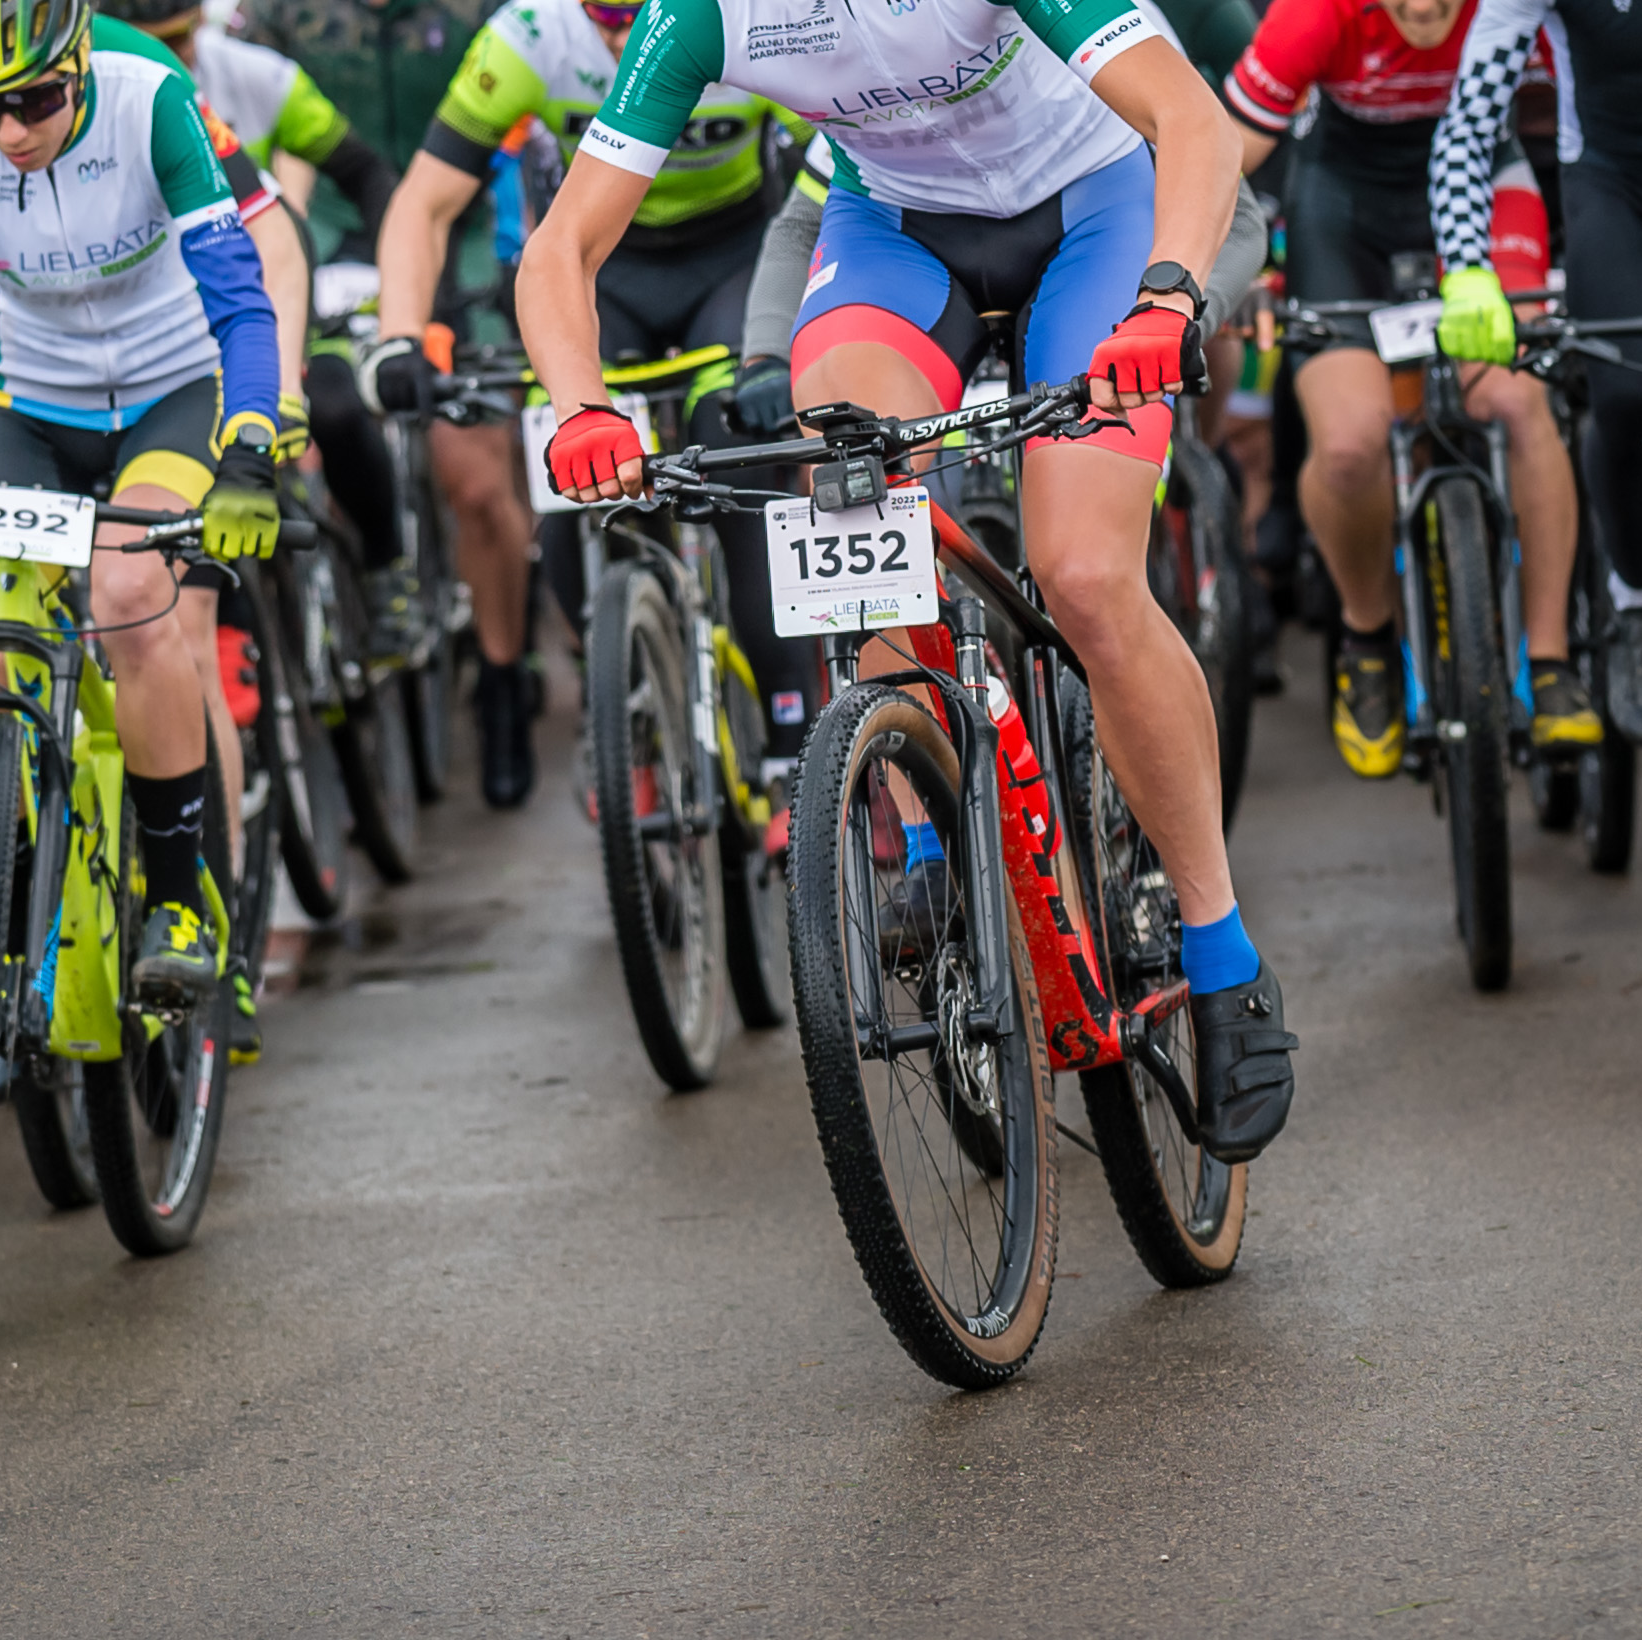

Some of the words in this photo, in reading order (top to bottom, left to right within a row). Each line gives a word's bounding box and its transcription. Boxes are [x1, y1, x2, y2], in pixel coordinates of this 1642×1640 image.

[1095, 17, 1143, 48] VELO.LV
[748, 37, 784, 52] KALNU
[749, 46, 808, 62] MARATONS
[812, 42, 836, 54] 2022
[863, 100, 946, 124] AVOTA
[588, 127, 627, 150] VELO.LV
[890, 495, 916, 506] 2022
[790, 530, 909, 581] 1352
[1037, 1112, 1059, 1285] THUNDER
